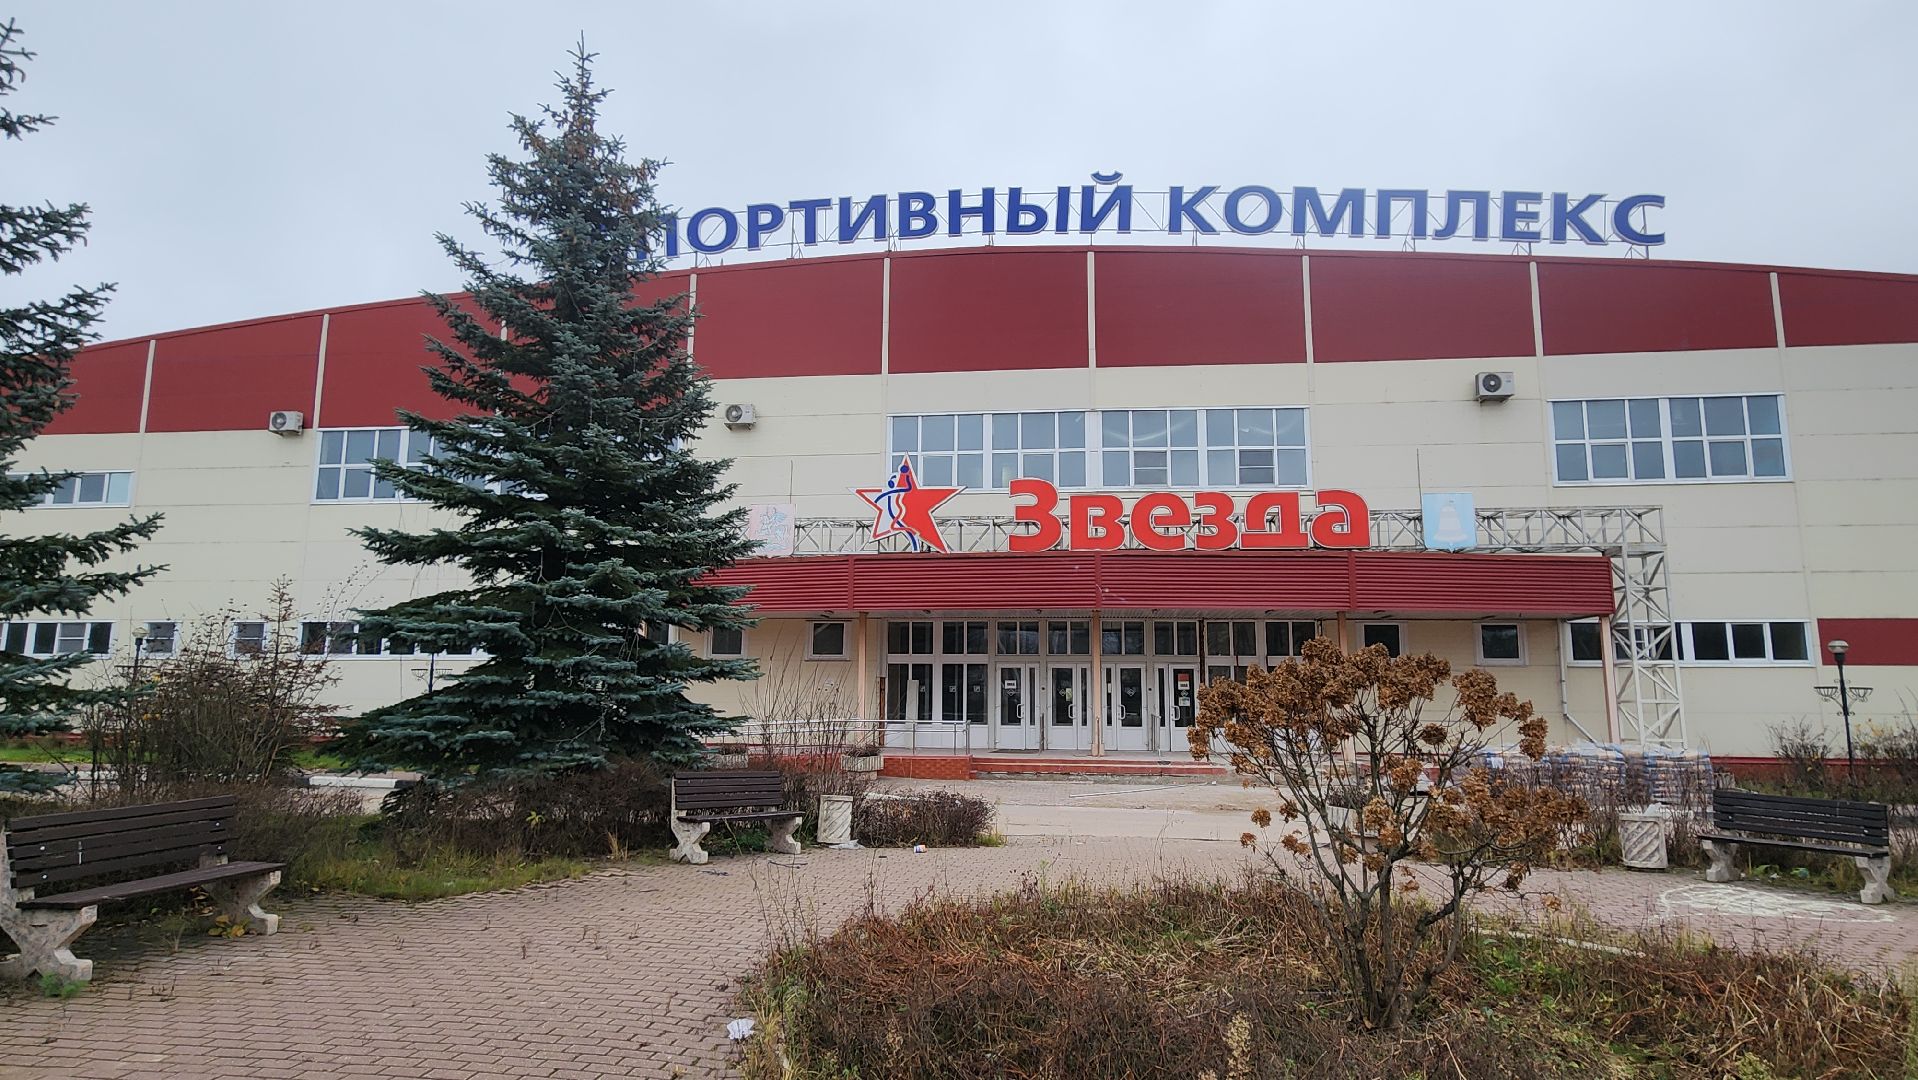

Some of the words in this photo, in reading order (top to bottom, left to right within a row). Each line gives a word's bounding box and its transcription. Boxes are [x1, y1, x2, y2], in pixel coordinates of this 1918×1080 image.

[615, 171, 1133, 261] ПОРТИВНЫЙ
[1168, 184, 1666, 246] КОМПЛЕКС
[1008, 478, 1371, 552] Звезда
